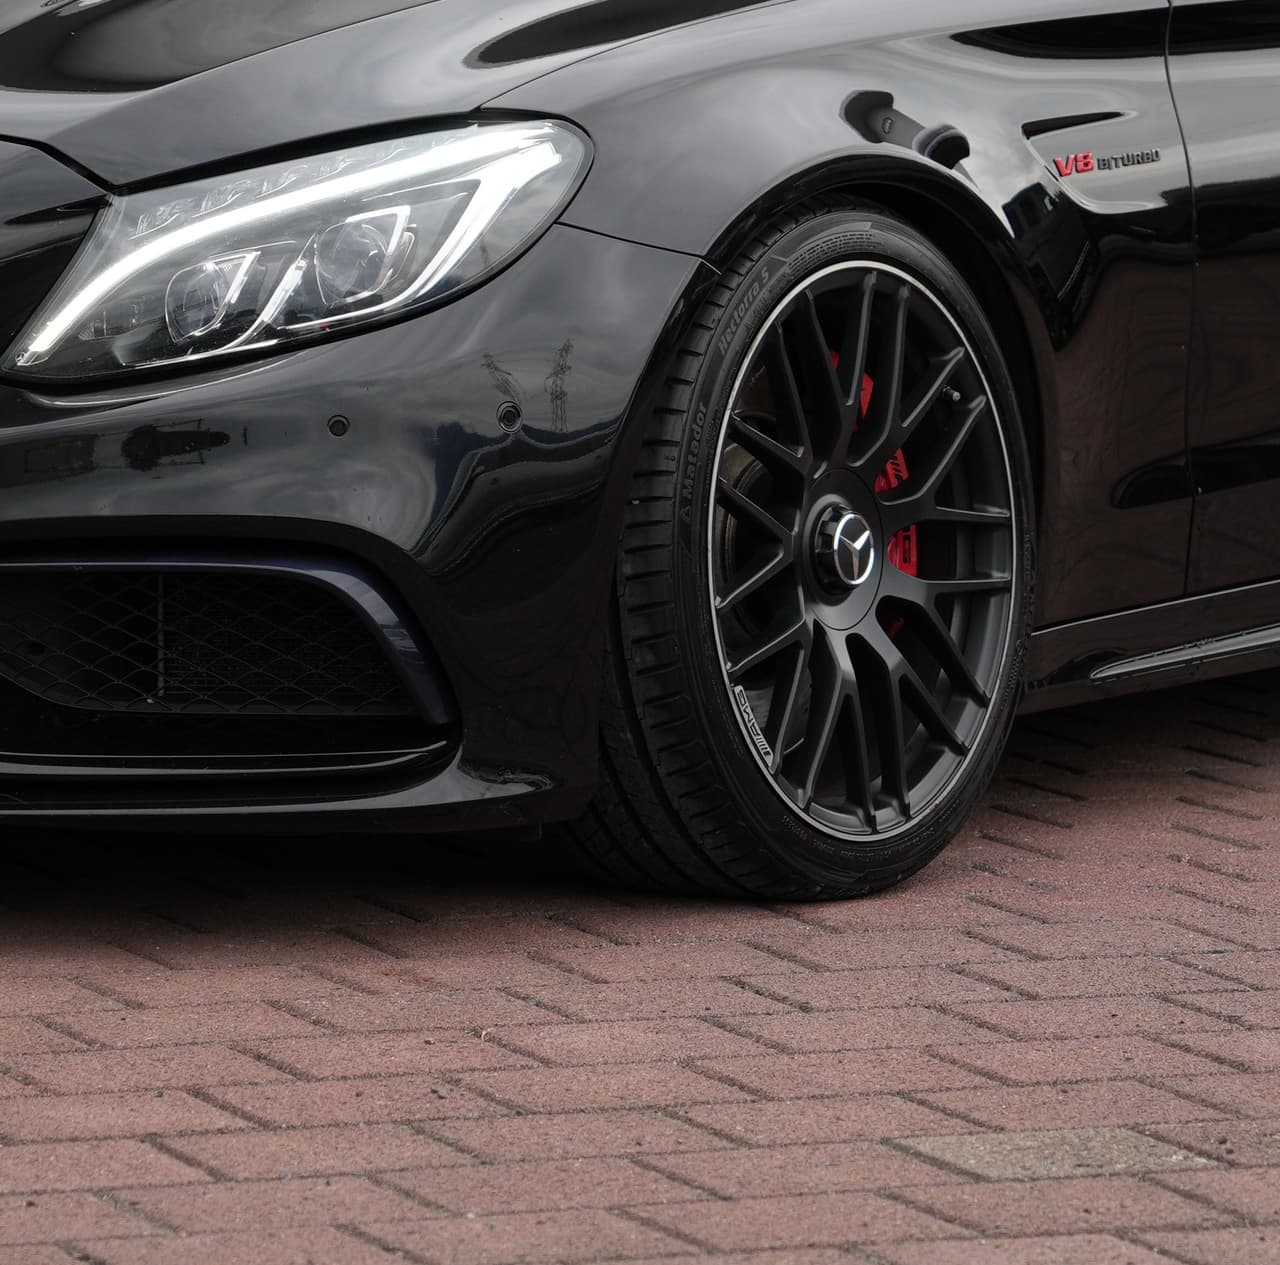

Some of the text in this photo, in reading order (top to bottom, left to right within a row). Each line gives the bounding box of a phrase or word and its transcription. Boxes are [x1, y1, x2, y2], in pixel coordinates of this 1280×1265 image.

[1053, 148, 1161, 177] V8 BITURBO
[718, 282, 760, 356] Hectorra
[761, 266, 769, 284] 5
[681, 401, 707, 499] Matador
